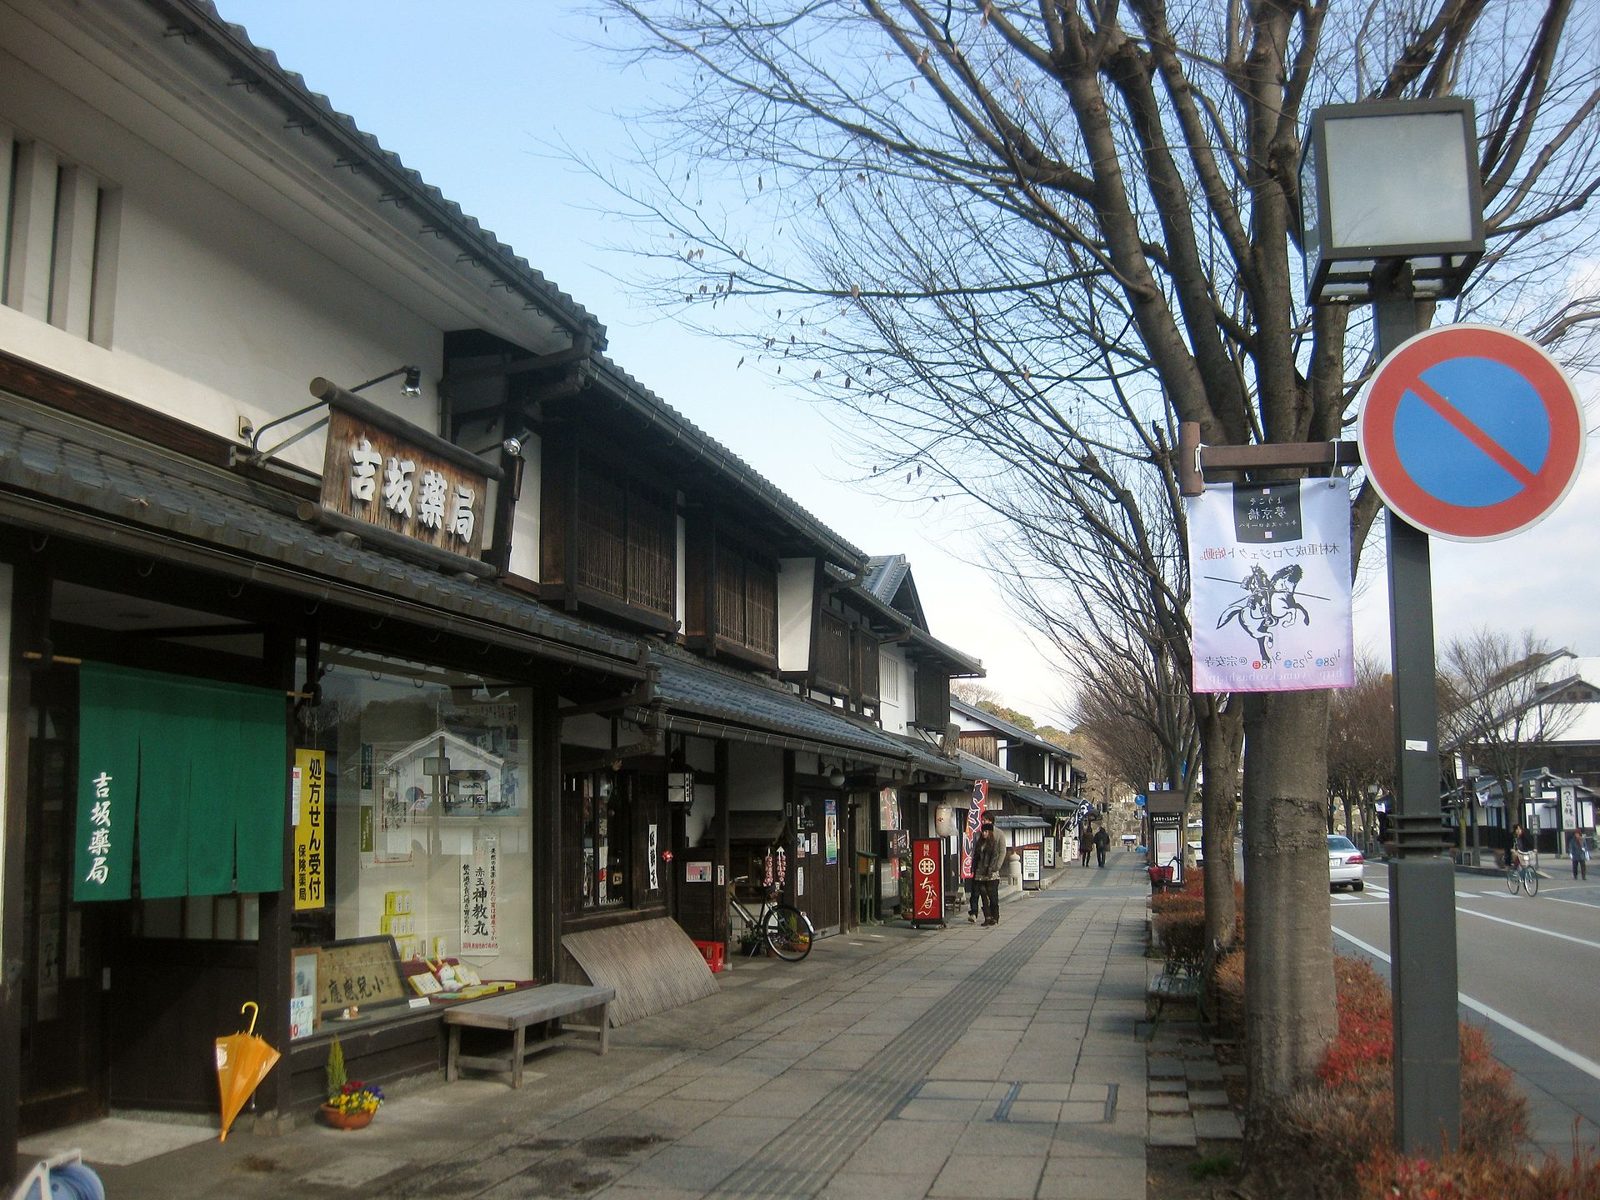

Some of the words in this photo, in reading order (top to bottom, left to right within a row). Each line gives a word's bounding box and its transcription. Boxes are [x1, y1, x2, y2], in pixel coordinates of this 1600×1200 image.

[349, 438, 475, 544] 吉坂薬局
[86, 771, 114, 884] 吉坂薬局
[298, 843, 307, 901] 保険薬局
[308, 757, 322, 901] 処方せん受付
